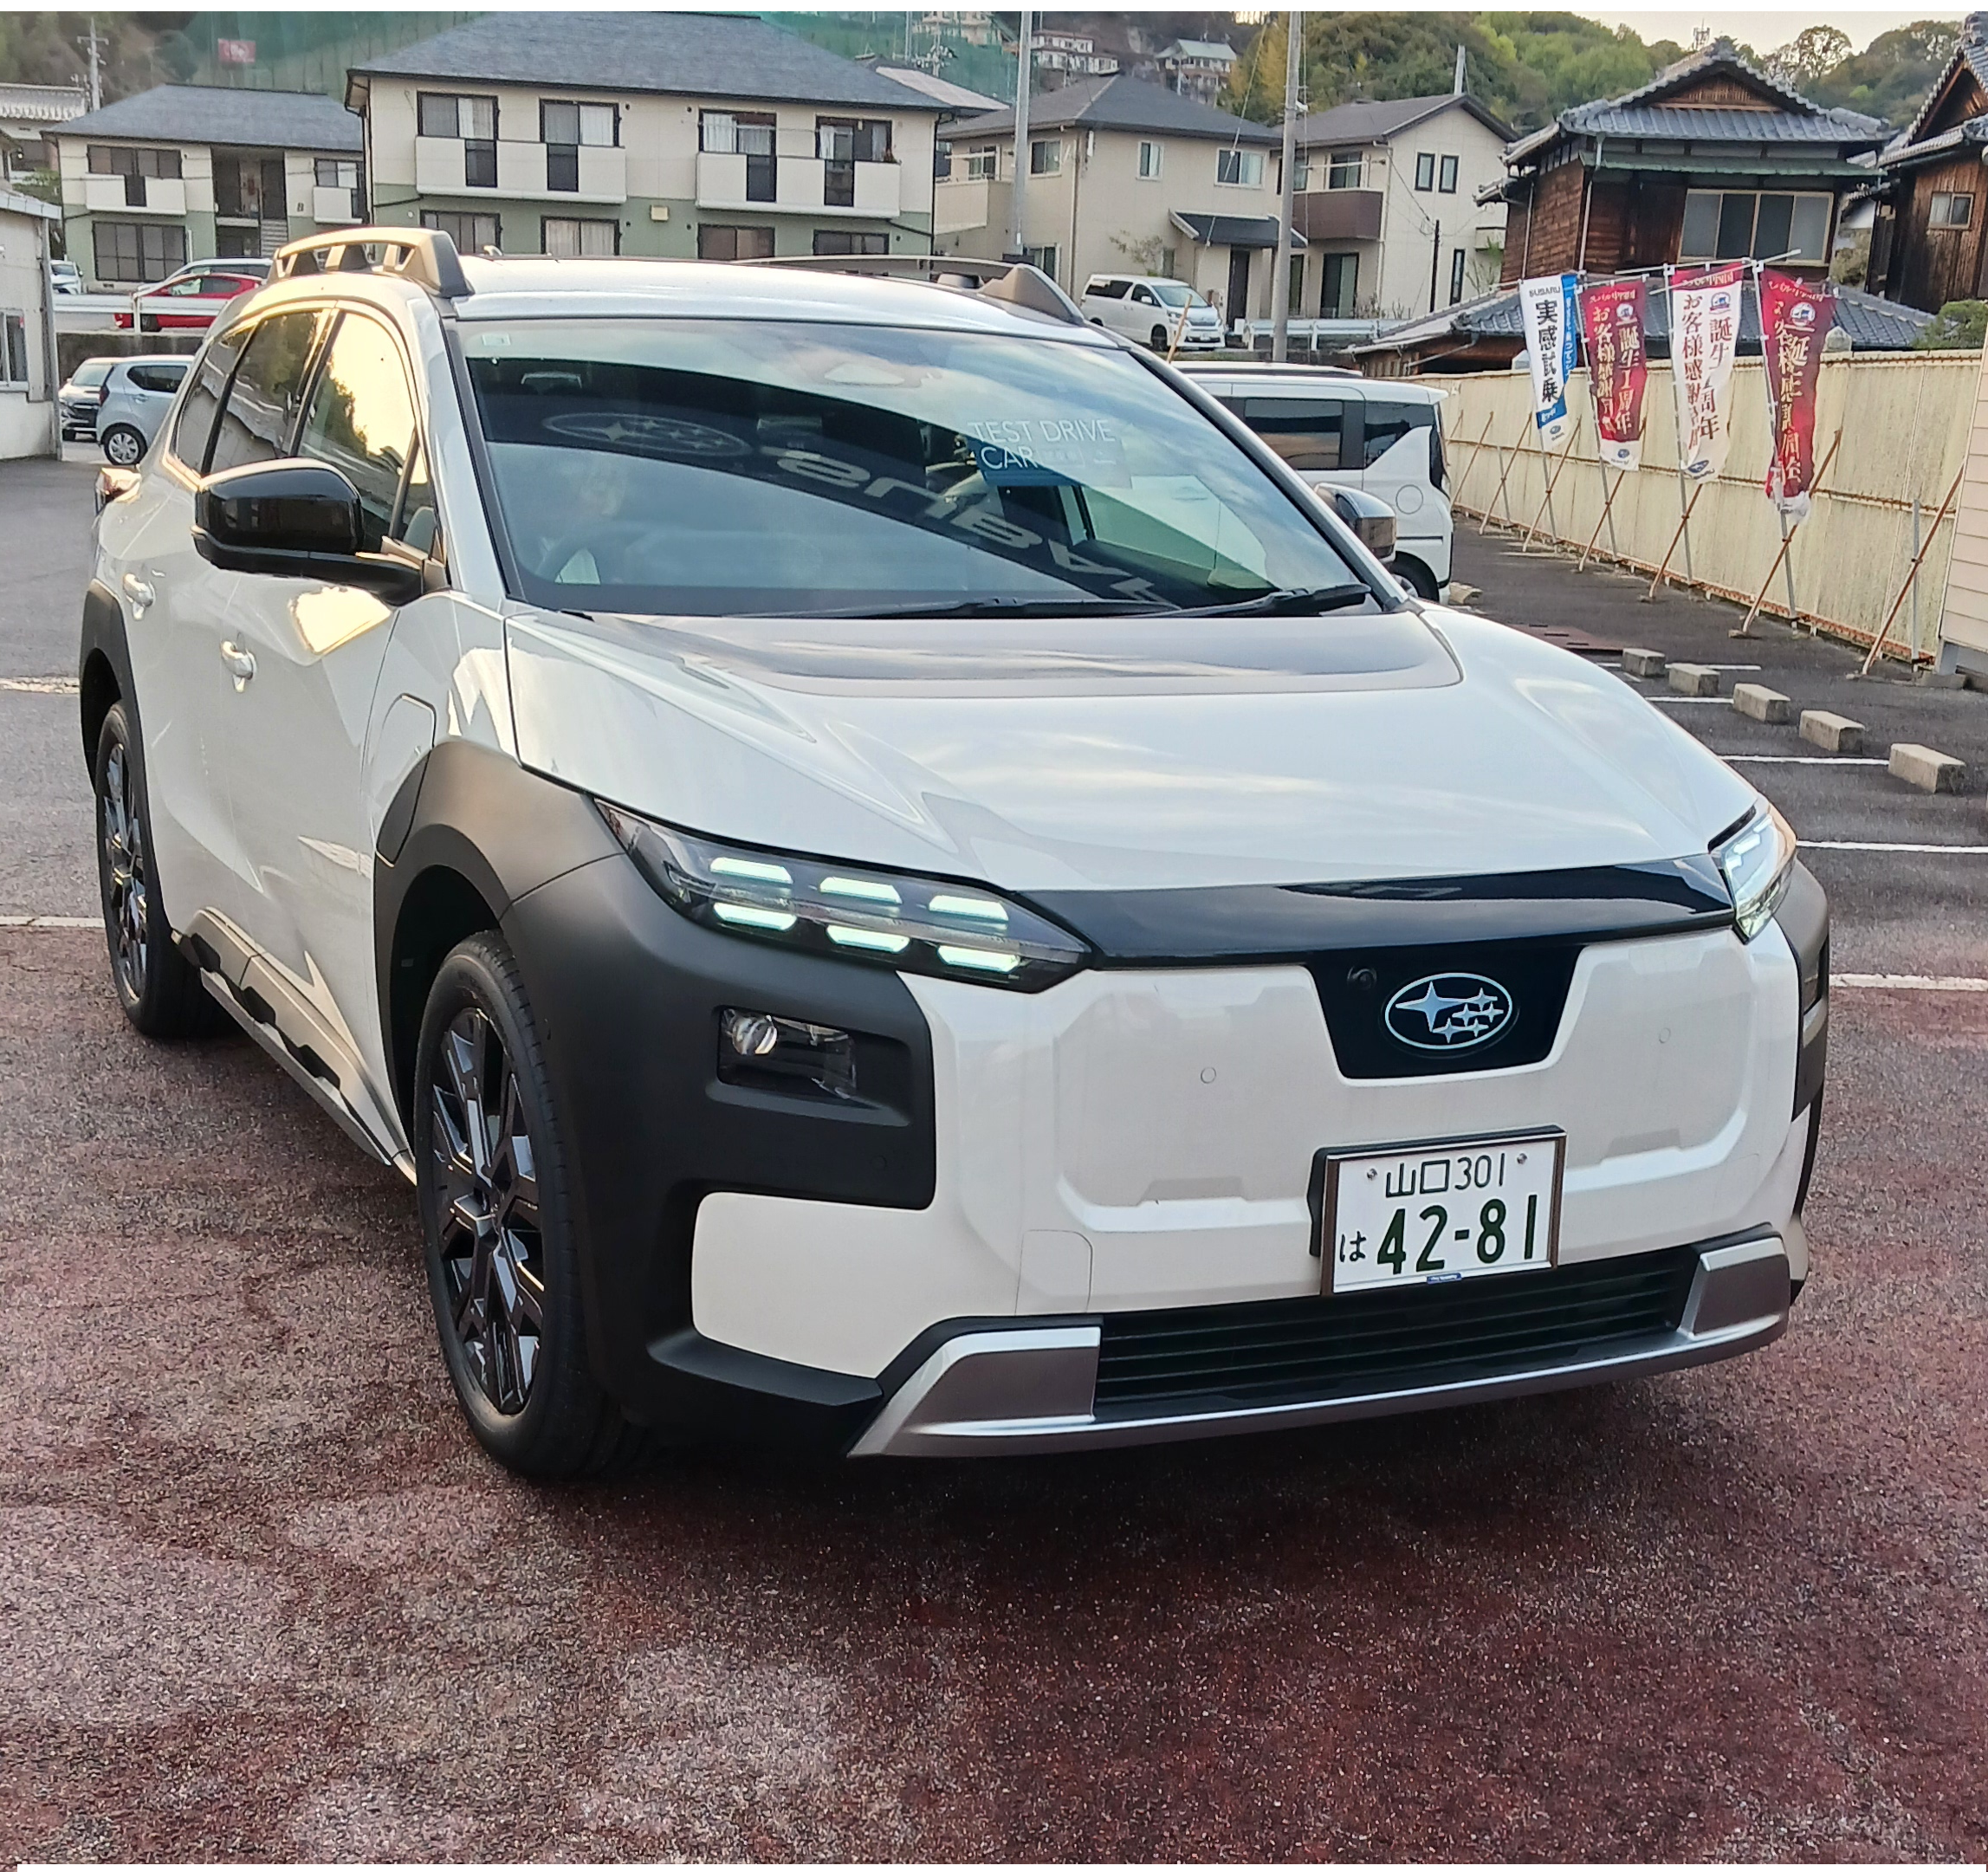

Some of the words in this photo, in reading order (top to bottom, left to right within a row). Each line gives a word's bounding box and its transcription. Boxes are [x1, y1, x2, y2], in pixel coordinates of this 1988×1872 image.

[1536, 300, 1559, 403] 実感試乗
[968, 420, 1033, 443] TEST
[1039, 419, 1116, 443] DRIVE
[981, 445, 1039, 470] CAR
[1339, 1230, 1367, 1263] は
[1376, 1194, 1538, 1275] 42-81
